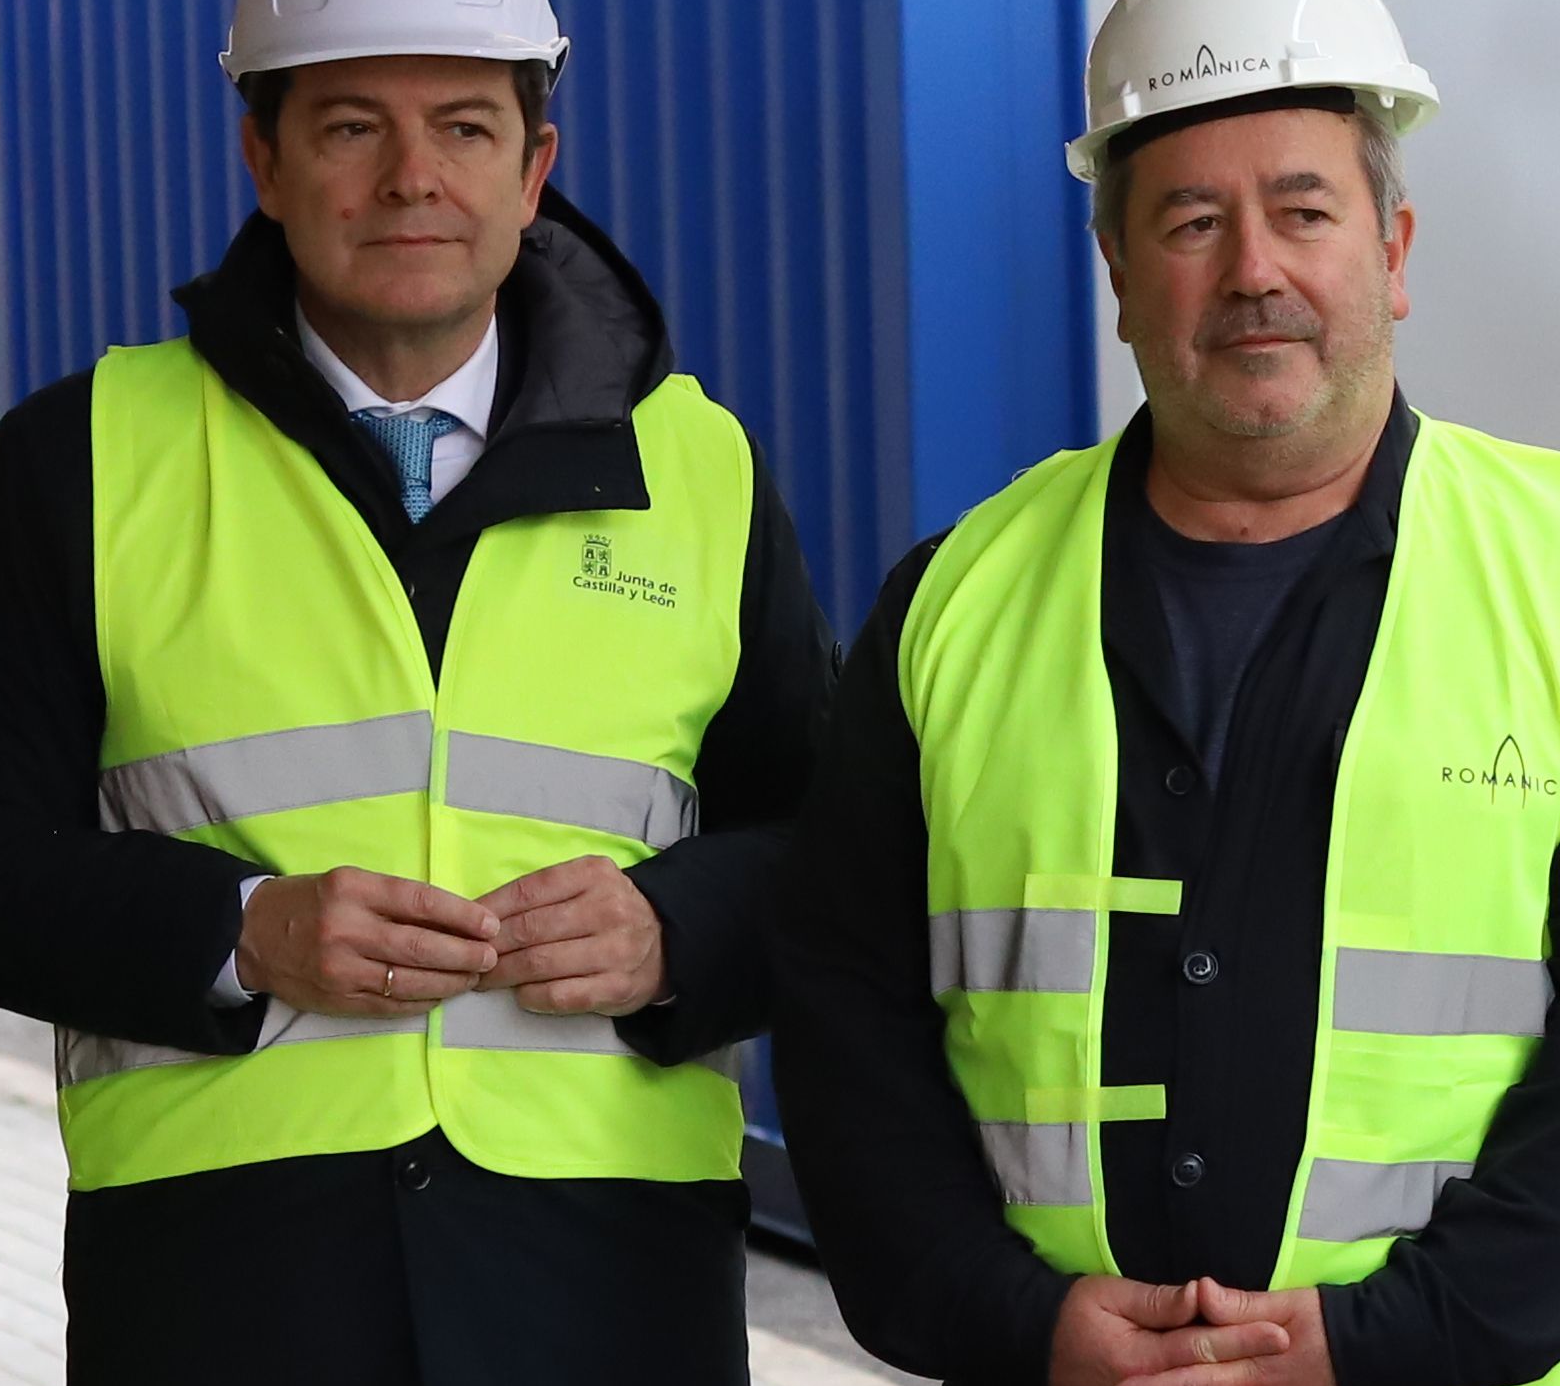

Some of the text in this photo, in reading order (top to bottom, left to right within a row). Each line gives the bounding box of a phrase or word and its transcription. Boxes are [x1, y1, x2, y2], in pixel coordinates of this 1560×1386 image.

[1148, 53, 1270, 91] ROMANICA
[573, 576, 676, 608] Castilla y León
[615, 571, 677, 595] Junta de
